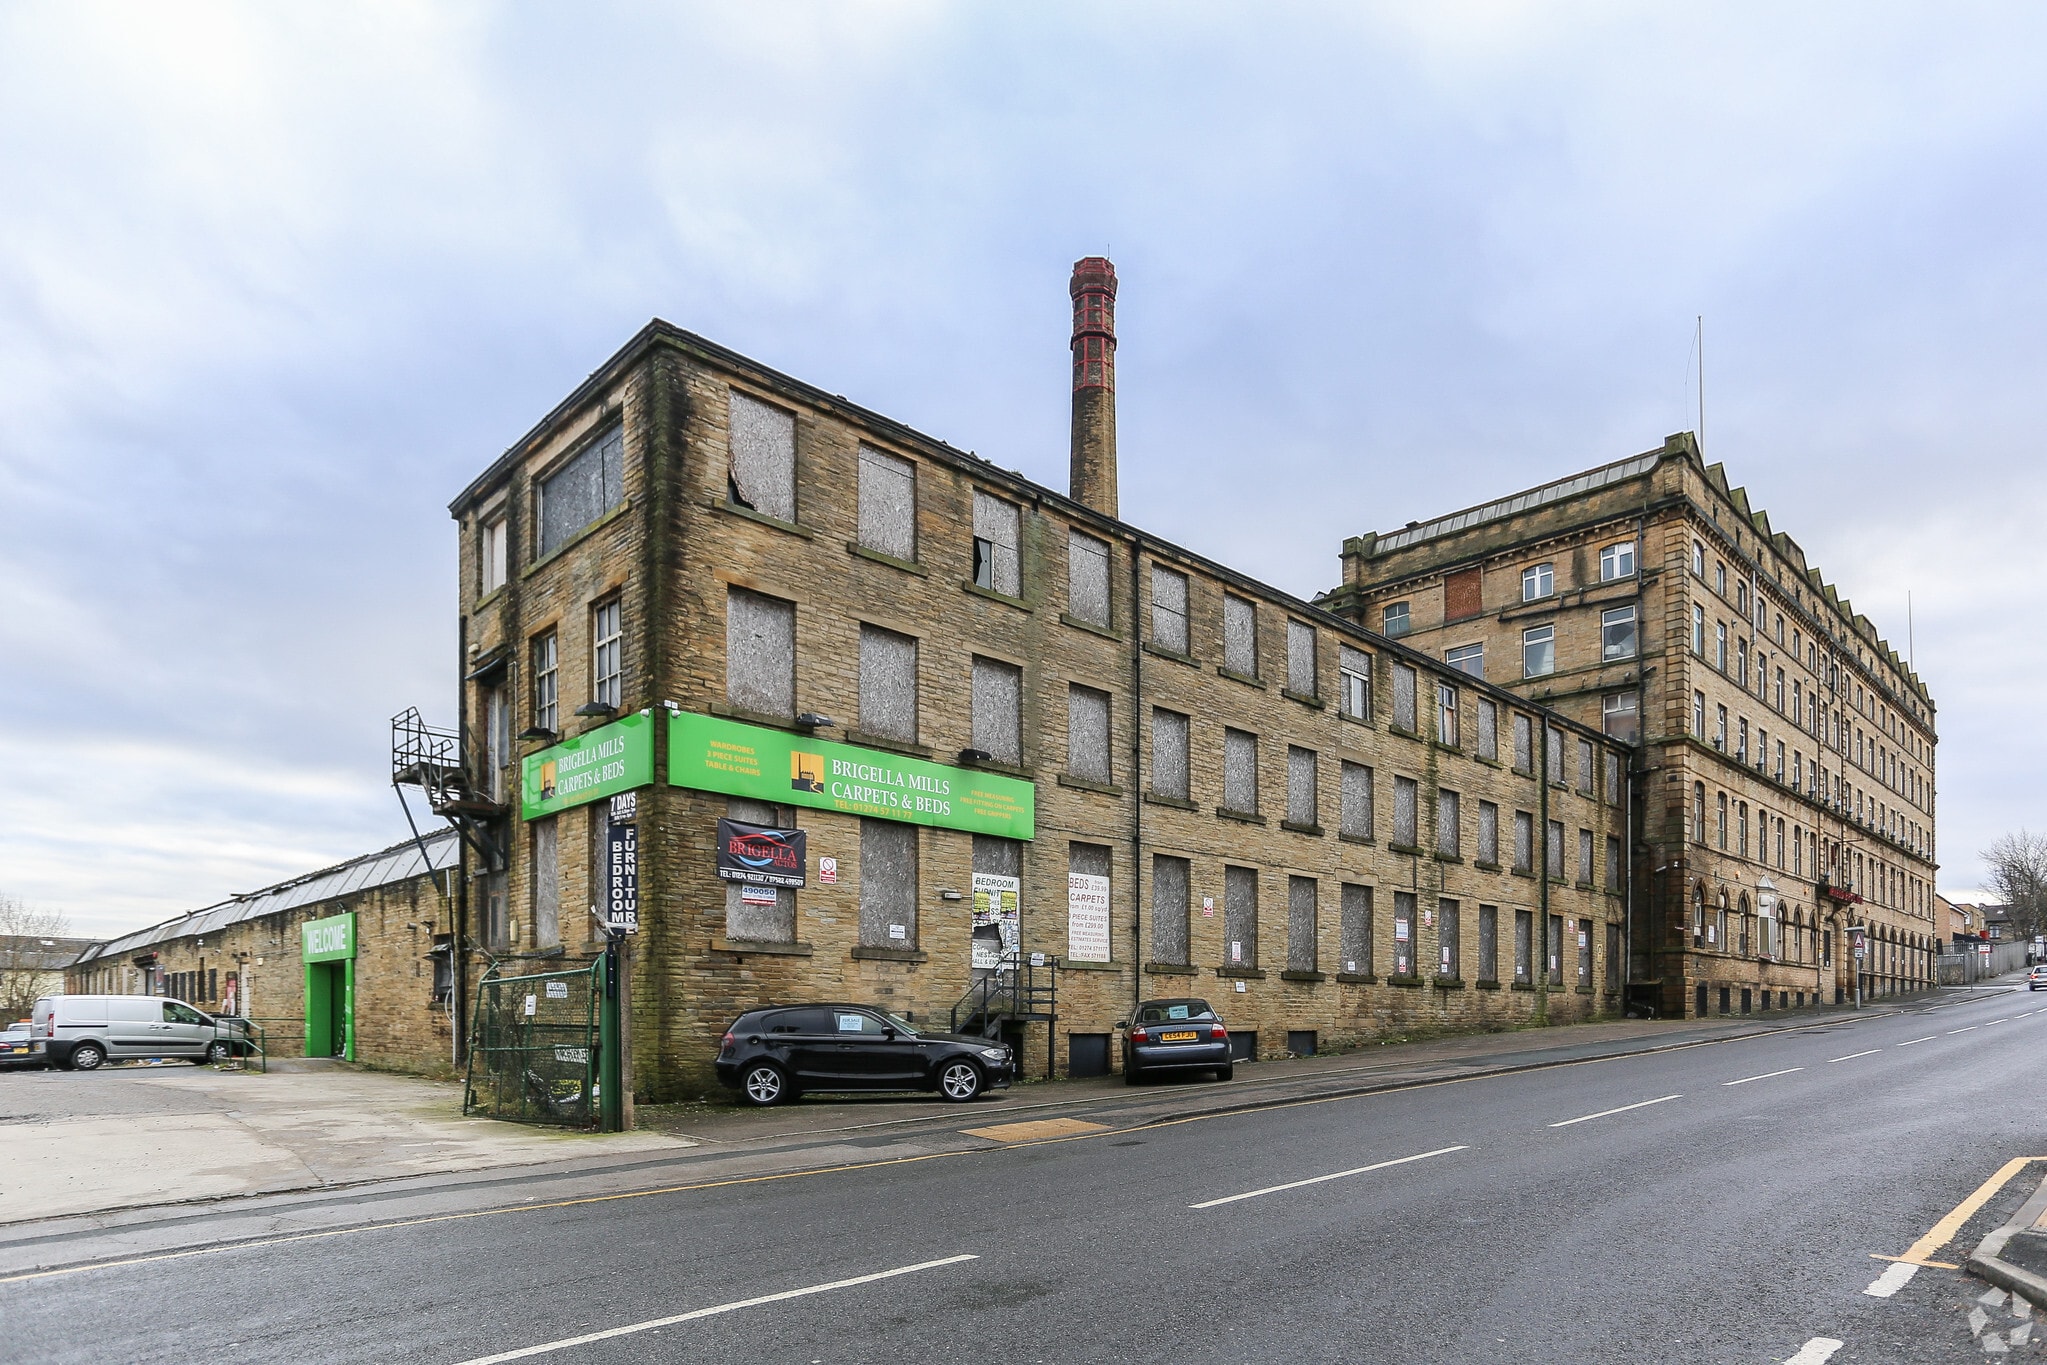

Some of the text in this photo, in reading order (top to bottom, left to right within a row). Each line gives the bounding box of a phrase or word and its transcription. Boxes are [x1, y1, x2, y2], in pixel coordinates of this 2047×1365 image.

[558, 735, 624, 773] BRIGELLA MILLS
[557, 759, 625, 795] CARPETS & BEDS
[832, 759, 950, 796] BRIGELLA MILLS
[610, 797, 616, 812] 7
[616, 791, 636, 811] DAYS
[831, 782, 951, 816] CARPETS & BEDS
[834, 800, 852, 810] TEL:
[853, 803, 879, 814] 01274
[880, 807, 889, 815] 57
[903, 811, 913, 819] 77
[728, 840, 797, 862] BRIGELLA
[773, 859, 798, 869] AUTOS
[611, 841, 624, 923] BEDROOM
[975, 877, 1014, 889] BEDROOM
[1069, 877, 1089, 890] BEDS
[1070, 893, 1105, 904] CARPETS
[306, 923, 346, 954] WELCOME
